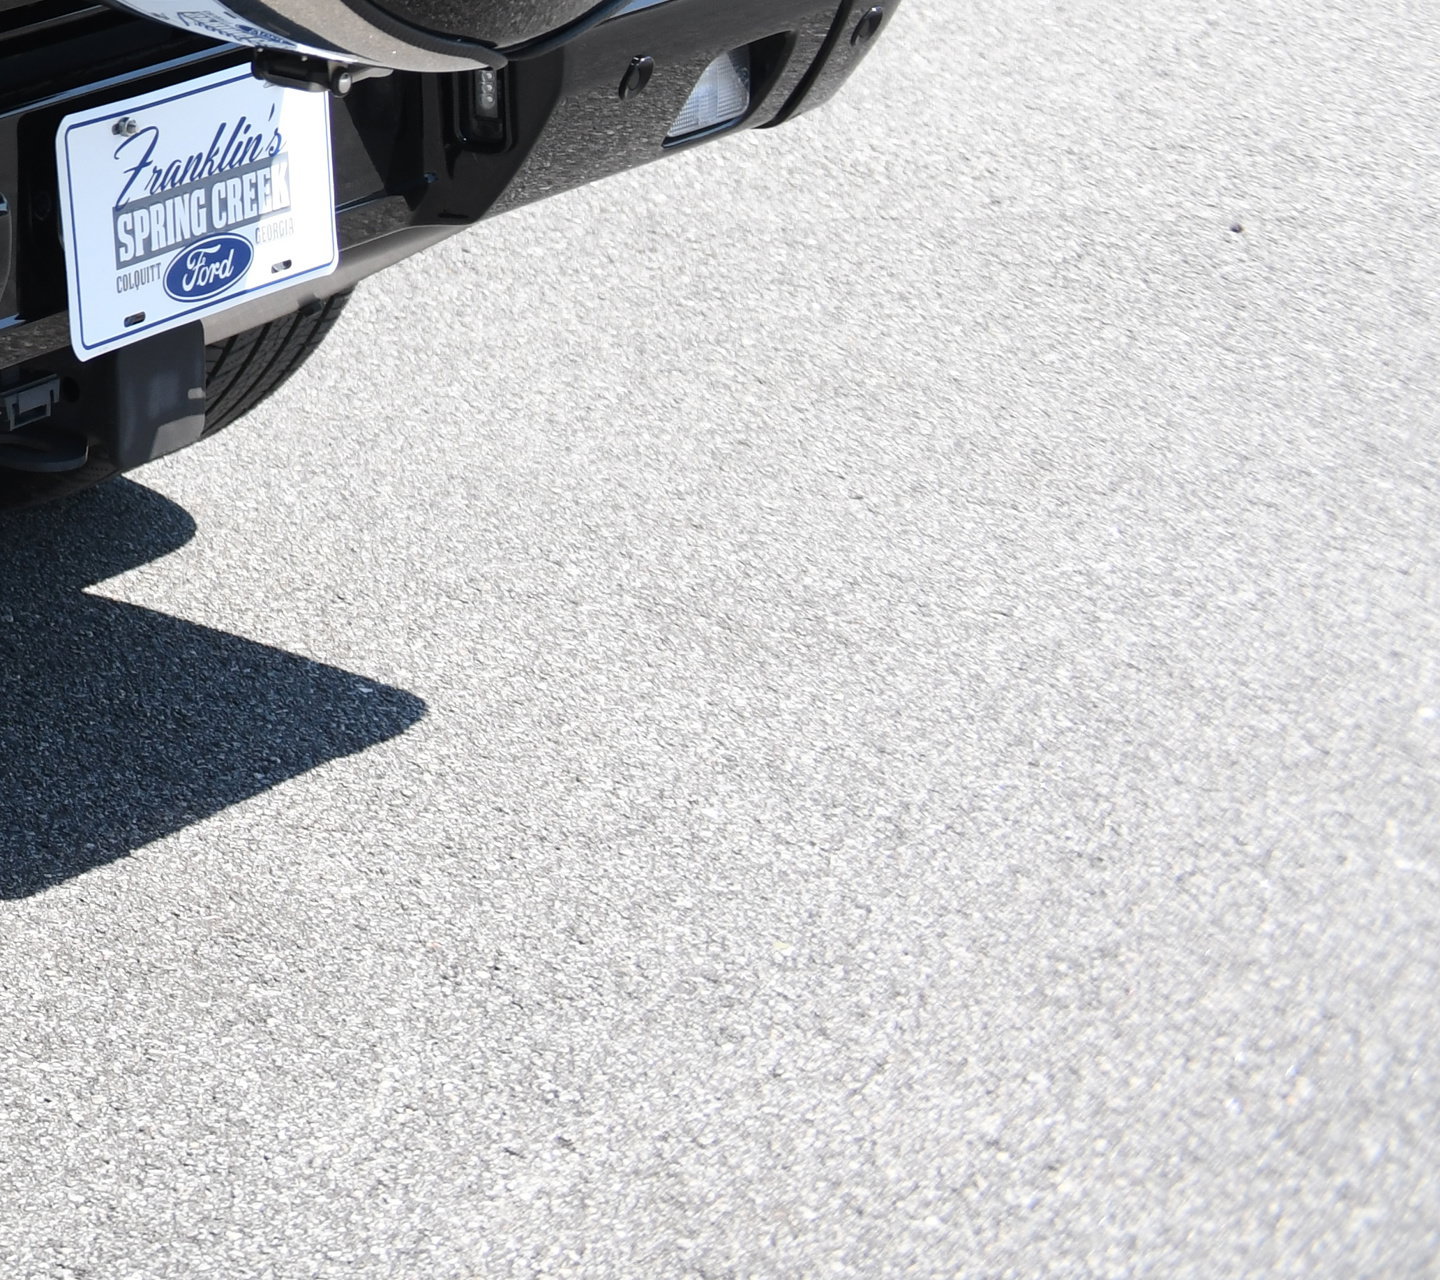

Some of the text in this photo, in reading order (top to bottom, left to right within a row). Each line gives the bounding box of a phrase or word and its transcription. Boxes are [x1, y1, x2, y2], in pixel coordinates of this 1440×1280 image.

[113, 102, 285, 211] Franklin's
[116, 162, 291, 262] SPRING CREEK
[254, 217, 295, 245] GEORGIA
[115, 262, 162, 294] COLQUITT
[182, 243, 235, 291] Ford
